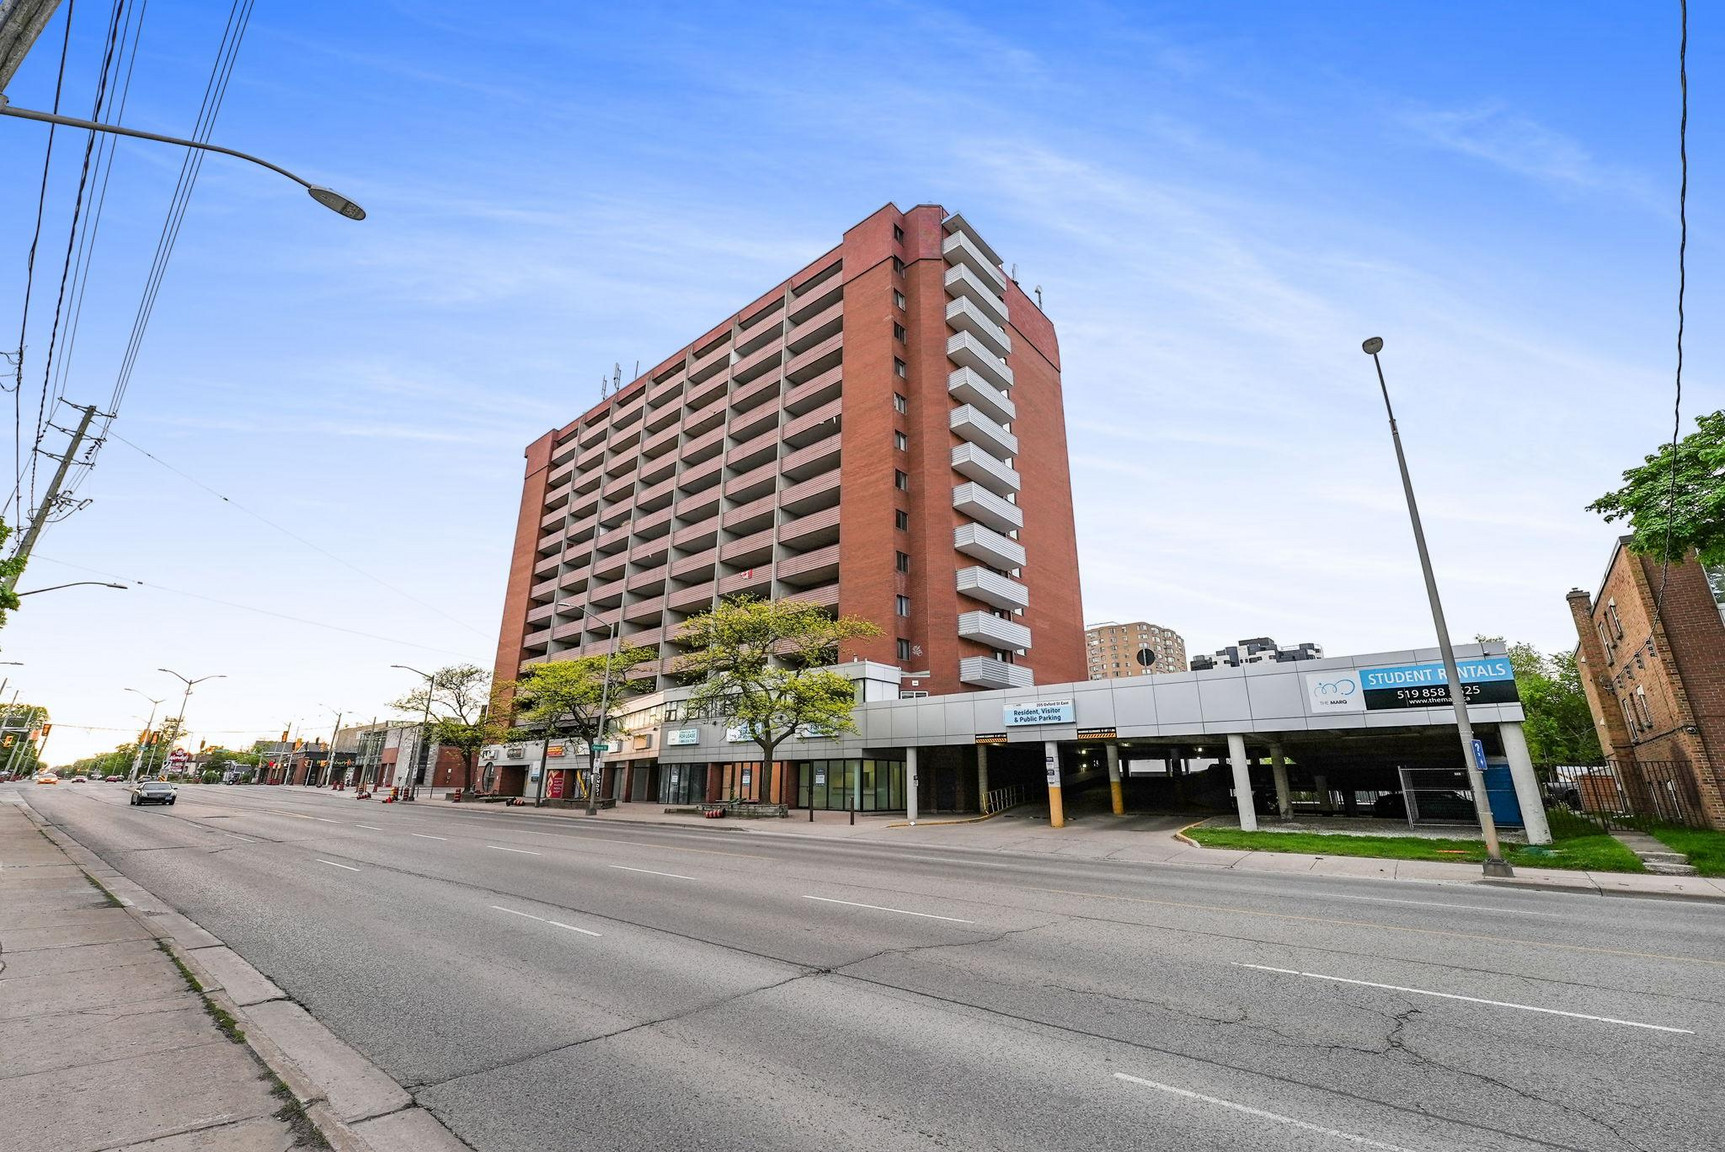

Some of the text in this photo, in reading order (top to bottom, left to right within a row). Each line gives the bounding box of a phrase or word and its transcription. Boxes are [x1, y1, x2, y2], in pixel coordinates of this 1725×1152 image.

[1368, 663, 1506, 685] STUDENT RNTALS
[1397, 689, 1419, 699] 519
[1422, 687, 1446, 698] 858
